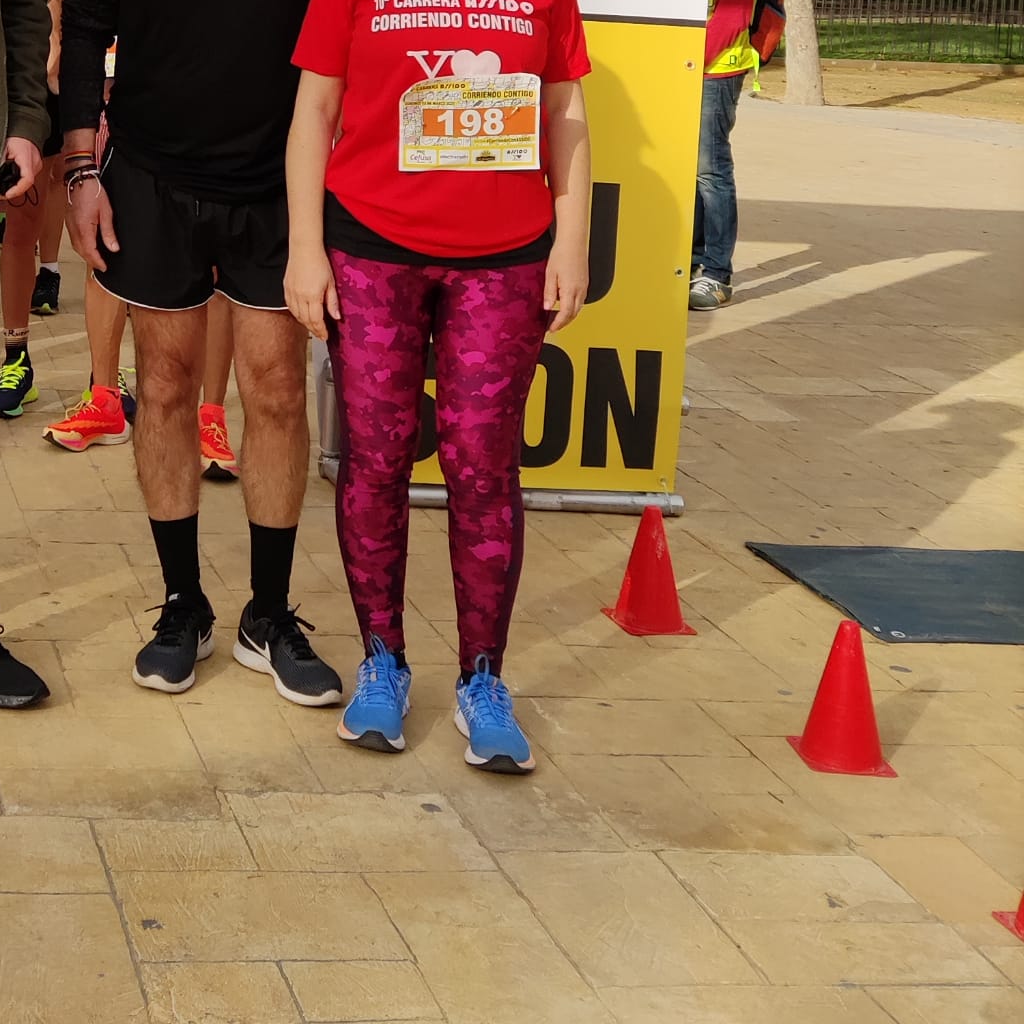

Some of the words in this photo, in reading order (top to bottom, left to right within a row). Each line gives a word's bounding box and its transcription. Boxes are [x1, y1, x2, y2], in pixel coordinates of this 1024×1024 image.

[370, 11, 464, 33] CORRIENDO
[467, 12, 534, 37] CONTIGO
[462, 90, 502, 100] CORRIENDO
[503, 89, 534, 98] CONTIGO
[437, 108, 505, 137] 198
